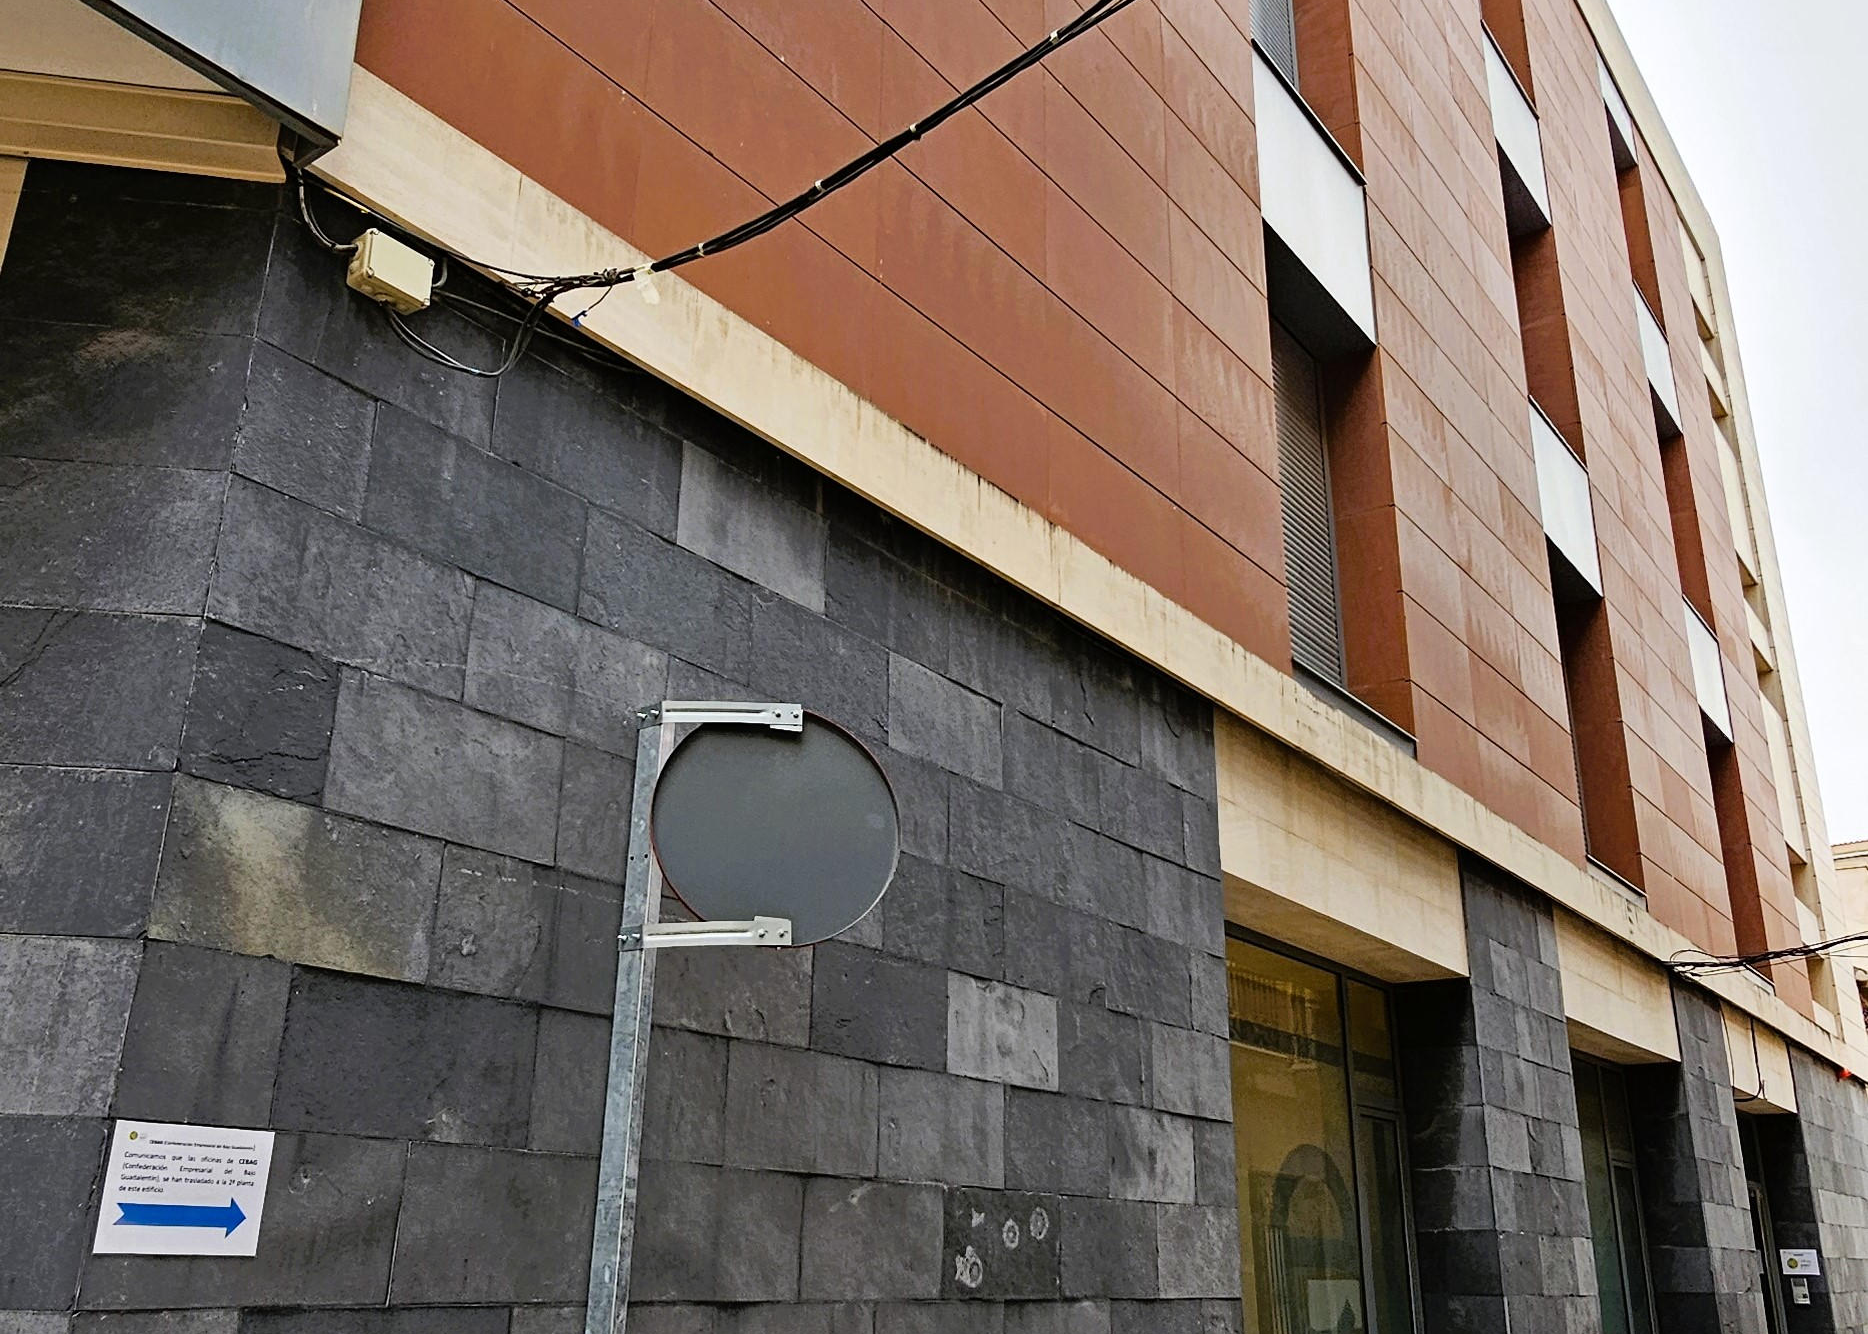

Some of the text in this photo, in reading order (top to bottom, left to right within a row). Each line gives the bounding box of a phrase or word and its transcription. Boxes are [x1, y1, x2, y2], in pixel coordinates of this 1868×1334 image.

[124, 1152, 166, 1160] Comunicamos
[201, 1155, 221, 1164] oficinas
[122, 1163, 168, 1171] (Confederación
[180, 1166, 212, 1174] Empresarial
[224, 1167, 233, 1175] del
[172, 1175, 183, 1183] han
[185, 1177, 214, 1185] trasladado
